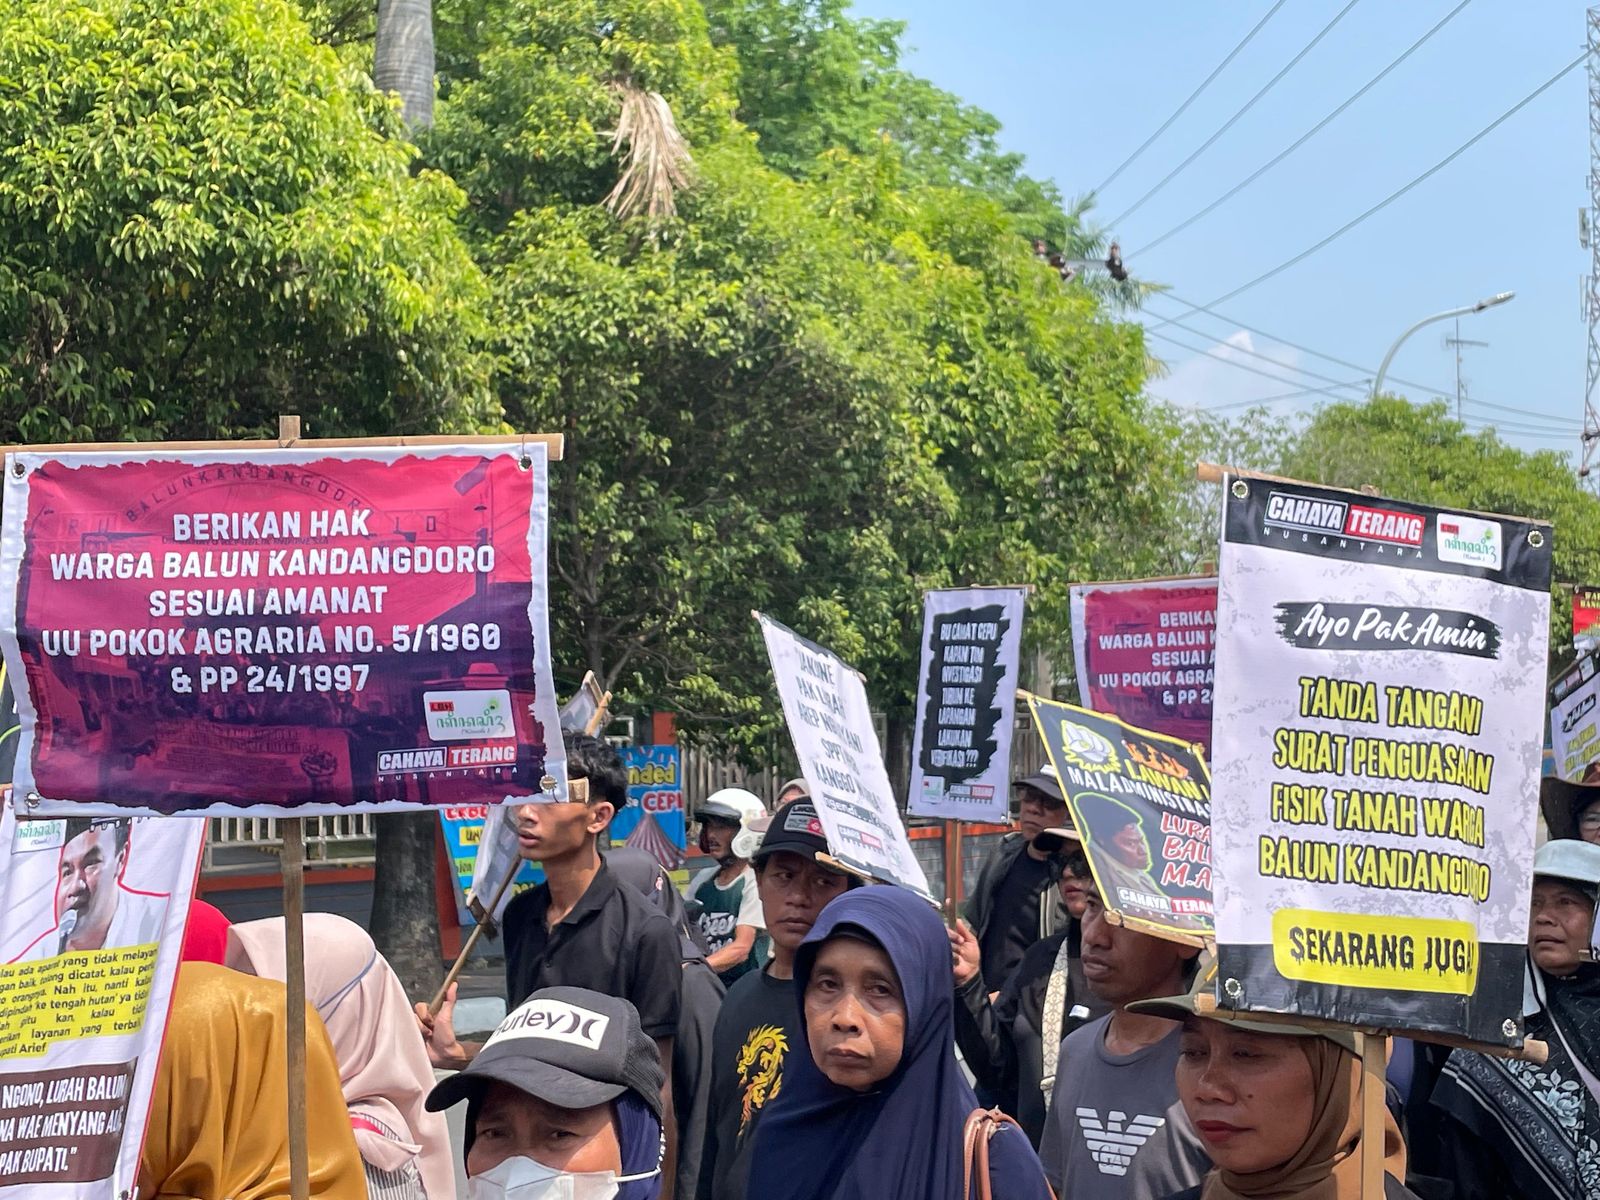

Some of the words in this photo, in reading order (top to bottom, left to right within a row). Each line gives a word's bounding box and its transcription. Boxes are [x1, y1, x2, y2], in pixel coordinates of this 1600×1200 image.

[173, 511, 301, 541] BERIKAN
[310, 509, 371, 538] HAK
[1268, 496, 1344, 529] CAHAYA
[1350, 509, 1423, 542] TERANG
[1263, 526, 1423, 559] NUSANTARA
[49, 551, 154, 580] WARGA
[163, 550, 259, 579] BALUN
[268, 545, 495, 577] KANDANGDORO
[149, 587, 255, 617] SESUAI
[263, 585, 388, 616] AMANAT
[42, 629, 81, 657] UU
[89, 628, 186, 656] POKOK
[194, 625, 326, 656] AGRARIA
[335, 625, 383, 653] NO.
[392, 623, 500, 652] 5/1960
[1099, 632, 1154, 650] WARGA
[1157, 629, 1207, 648] BALUN
[1294, 603, 1351, 646] Ayo
[1352, 607, 1413, 641] Pak
[1410, 612, 1488, 651] Amin
[1151, 650, 1206, 667] SESUAI
[171, 666, 193, 694] &
[201, 666, 239, 693] PP
[246, 664, 370, 693] 24/1997
[1099, 673, 1119, 688] UU
[1122, 671, 1172, 688] POKOK
[1162, 691, 1175, 706] &
[1177, 689, 1198, 705] PP
[1298, 675, 1380, 723] TANDA
[1385, 685, 1484, 737] TANGANI
[379, 750, 444, 770] CAHAYA
[451, 746, 515, 764] TERANG
[1272, 726, 1350, 776] SURAT
[1351, 736, 1496, 795] PENGUASAAN
[378, 767, 518, 782] NUSANTARA
[1124, 759, 1204, 801] LAWAN
[1270, 781, 1329, 826] FISIK
[1332, 788, 1419, 838] TANAH
[1421, 796, 1486, 849] WARGA
[1259, 834, 1340, 885] BALUN
[1120, 889, 1169, 910] CAHAYA
[62, 956, 89, 969] yang
[94, 952, 119, 965] tidak
[1289, 925, 1414, 972] SEKARANG
[110, 965, 135, 976] kalau
[51, 997, 86, 1010] tengah
[120, 993, 132, 1004] ya
[54, 985, 76, 995] Nah
[104, 978, 129, 990] nanti
[91, 1008, 115, 1019] kalau
[32, 1028, 71, 1040] layanan
[80, 1024, 102, 1036] yang
[19, 1042, 47, 1054] Arief
[2, 1081, 45, 1109] NGONO,
[46, 1077, 86, 1104] LURAH
[17, 1114, 43, 1140] WAE
[41, 1110, 107, 1138] MENYANG
